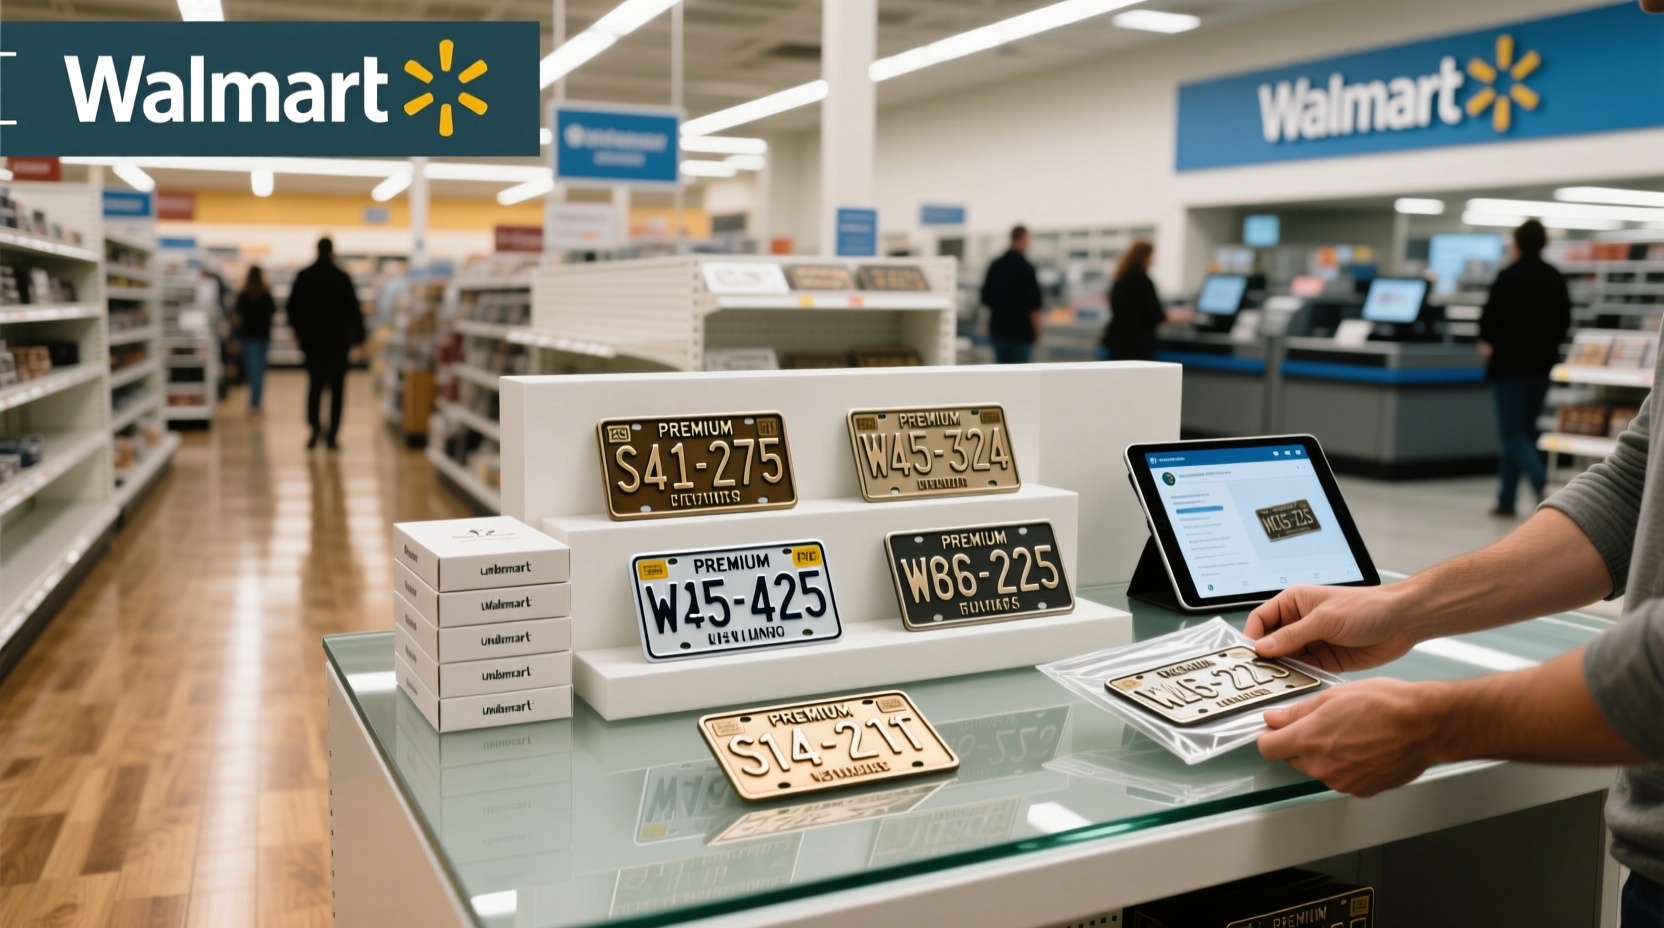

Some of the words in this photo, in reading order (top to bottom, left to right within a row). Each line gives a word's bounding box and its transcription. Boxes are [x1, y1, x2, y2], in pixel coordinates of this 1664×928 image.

[1257, 55, 1464, 143] Walmart
[658, 419, 734, 438] PREMIUM
[899, 411, 961, 429] PREMIUM
[859, 427, 1009, 479] W45-324
[615, 437, 784, 494] S41-275
[941, 530, 1008, 550] PREMIUM
[694, 553, 770, 574] PREMIUM
[767, 703, 854, 727] PREMIUM
